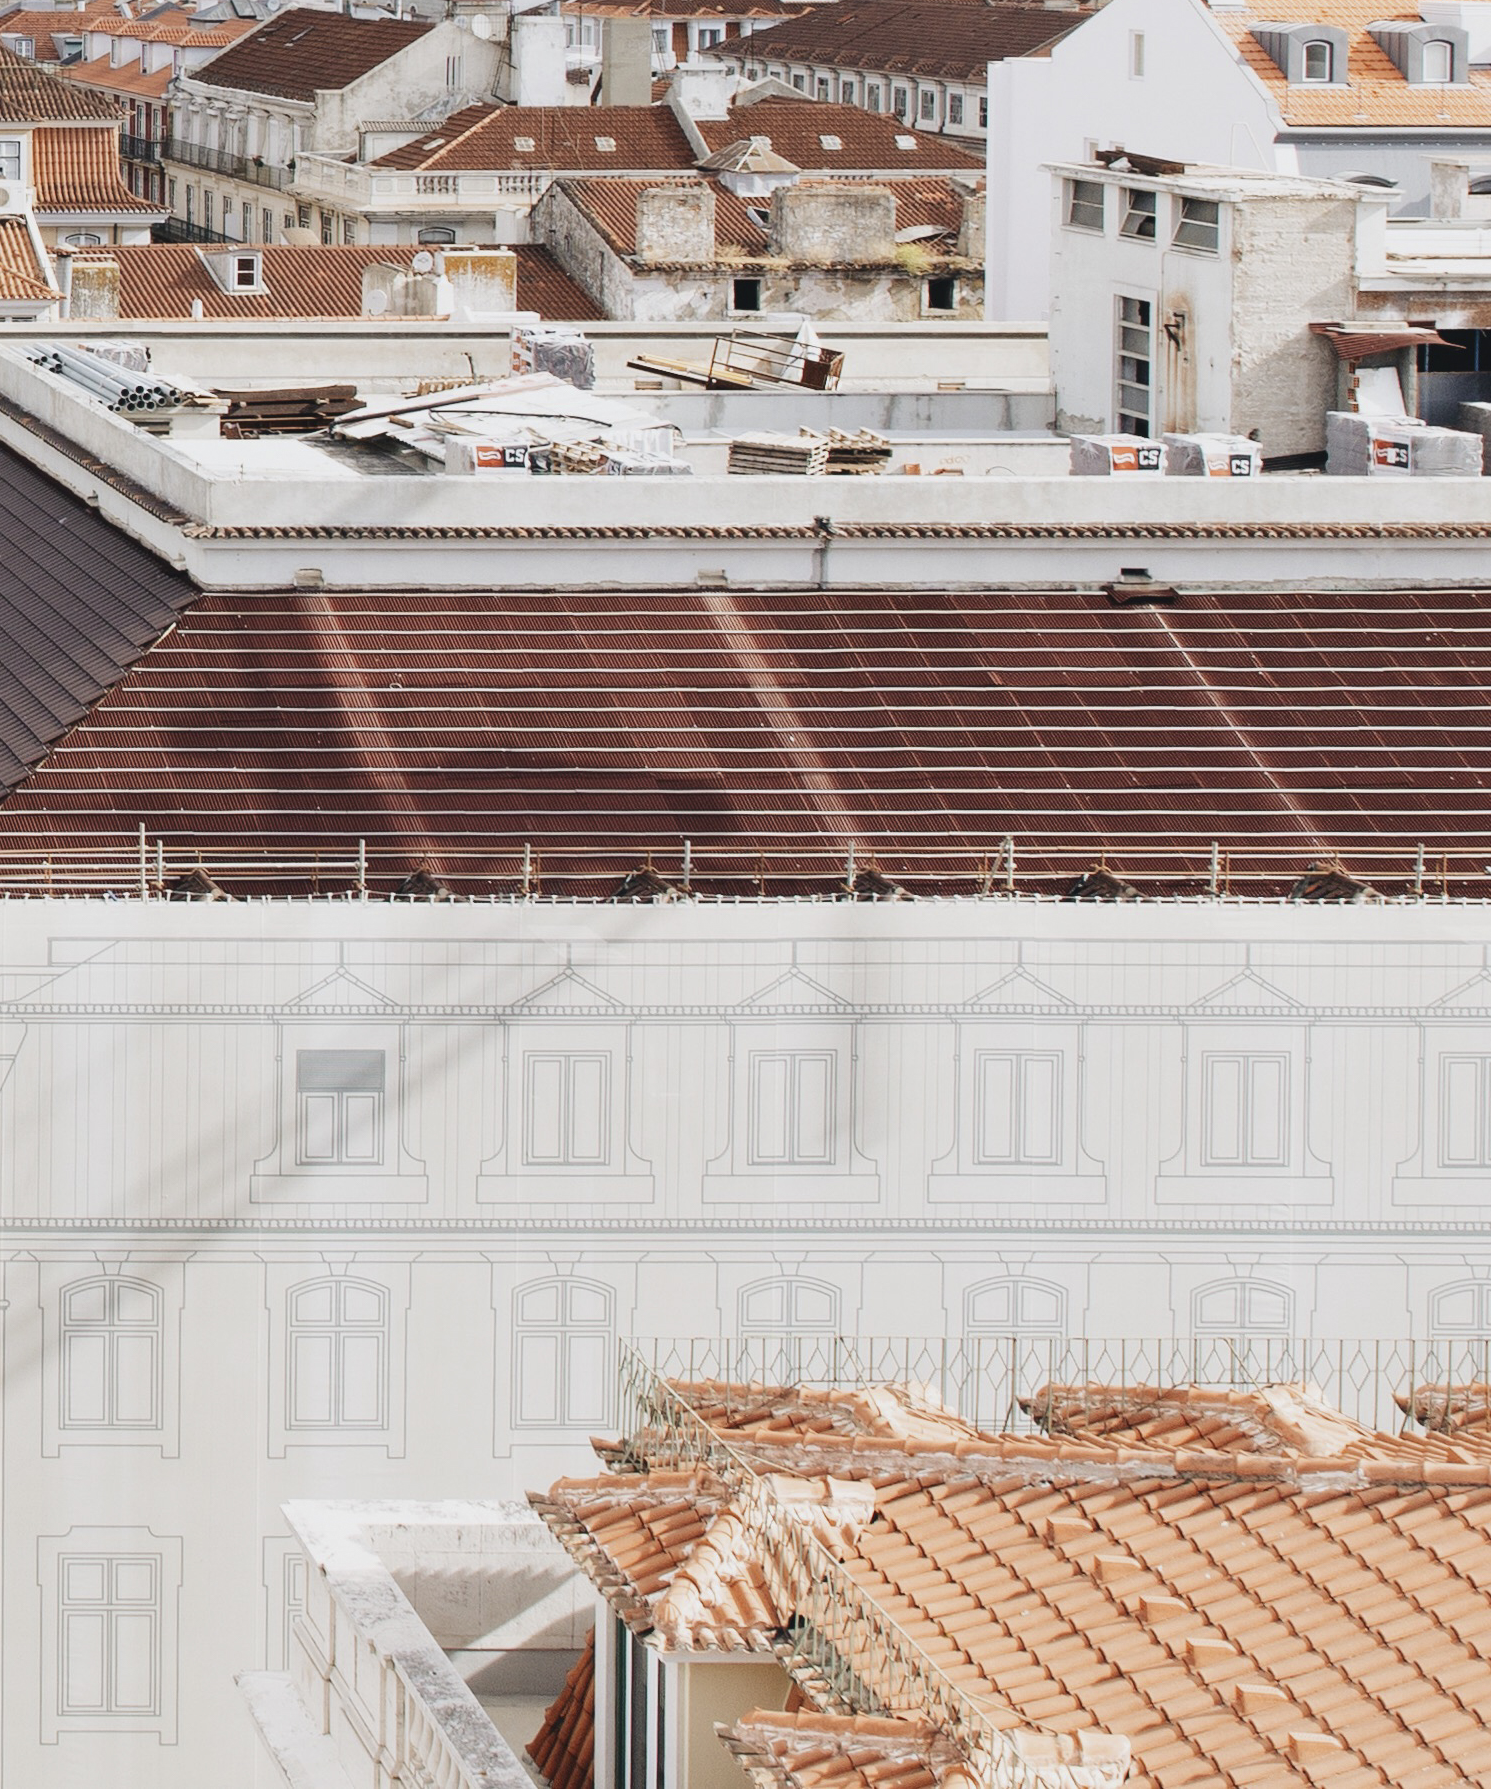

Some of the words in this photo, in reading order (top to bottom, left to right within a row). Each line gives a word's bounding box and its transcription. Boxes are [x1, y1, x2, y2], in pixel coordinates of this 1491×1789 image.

[505, 448, 525, 462] CS
[1138, 450, 1160, 465] CS
[1231, 460, 1250, 474] CS
